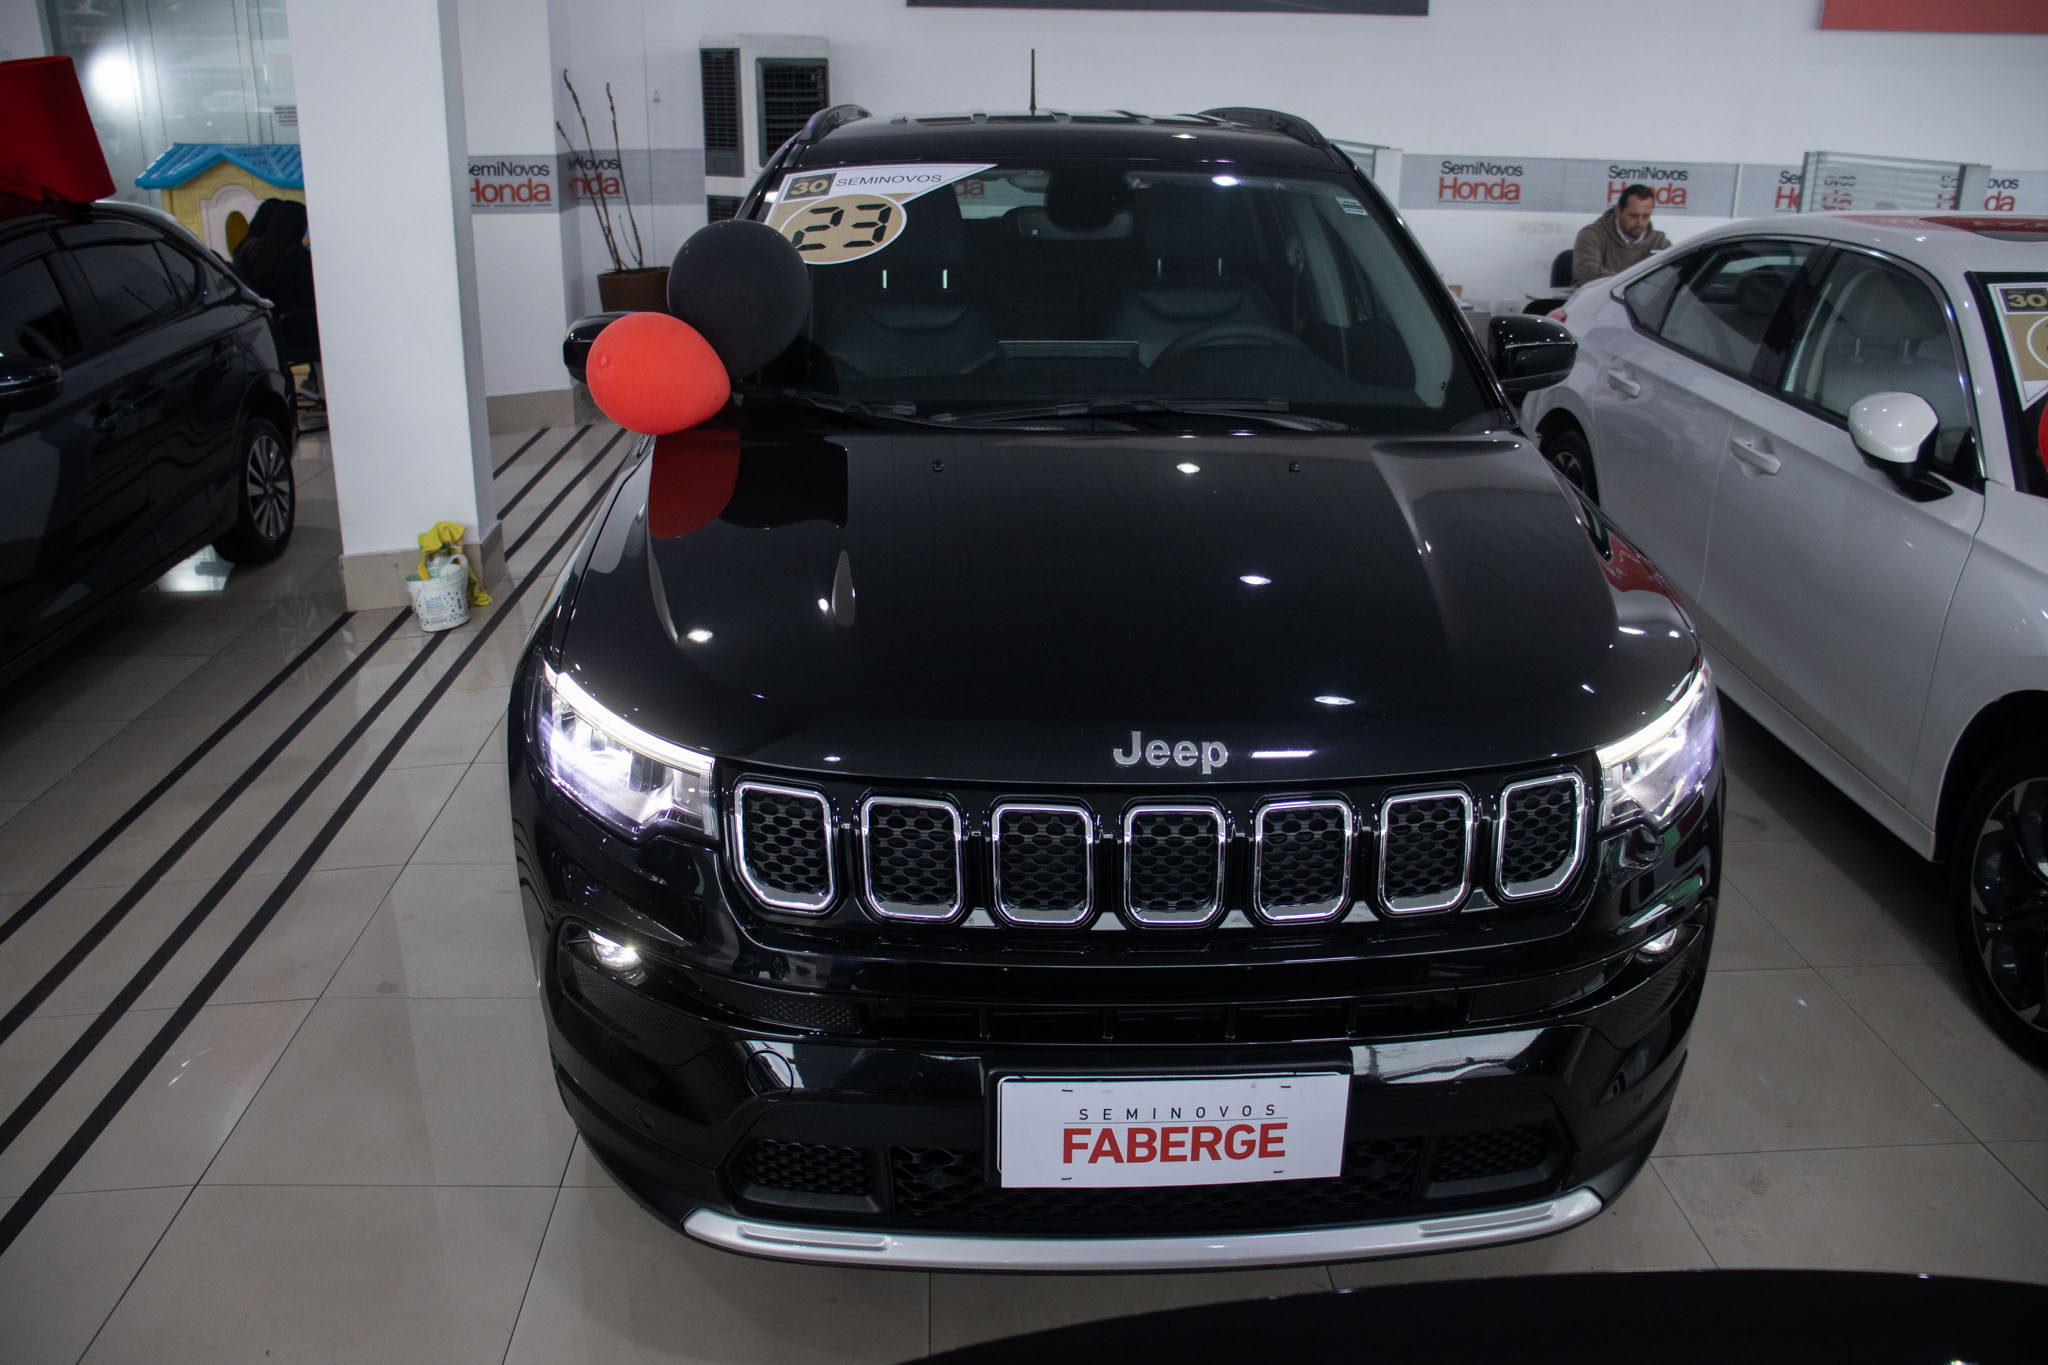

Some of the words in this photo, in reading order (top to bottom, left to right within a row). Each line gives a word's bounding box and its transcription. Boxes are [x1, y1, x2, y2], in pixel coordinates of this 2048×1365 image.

[1441, 160, 1523, 176] SemiNovos
[1608, 165, 1688, 181] SemiNovos
[790, 179, 829, 195] 30
[836, 174, 943, 188] SEMINOVOS
[1438, 176, 1520, 201] Honda
[791, 203, 893, 251] 23
[2007, 293, 2048, 308] 30
[1113, 730, 1229, 775] Jeep
[1078, 1104, 1276, 1121] SEMINOVOS
[1062, 1122, 1288, 1164] FABERGE
